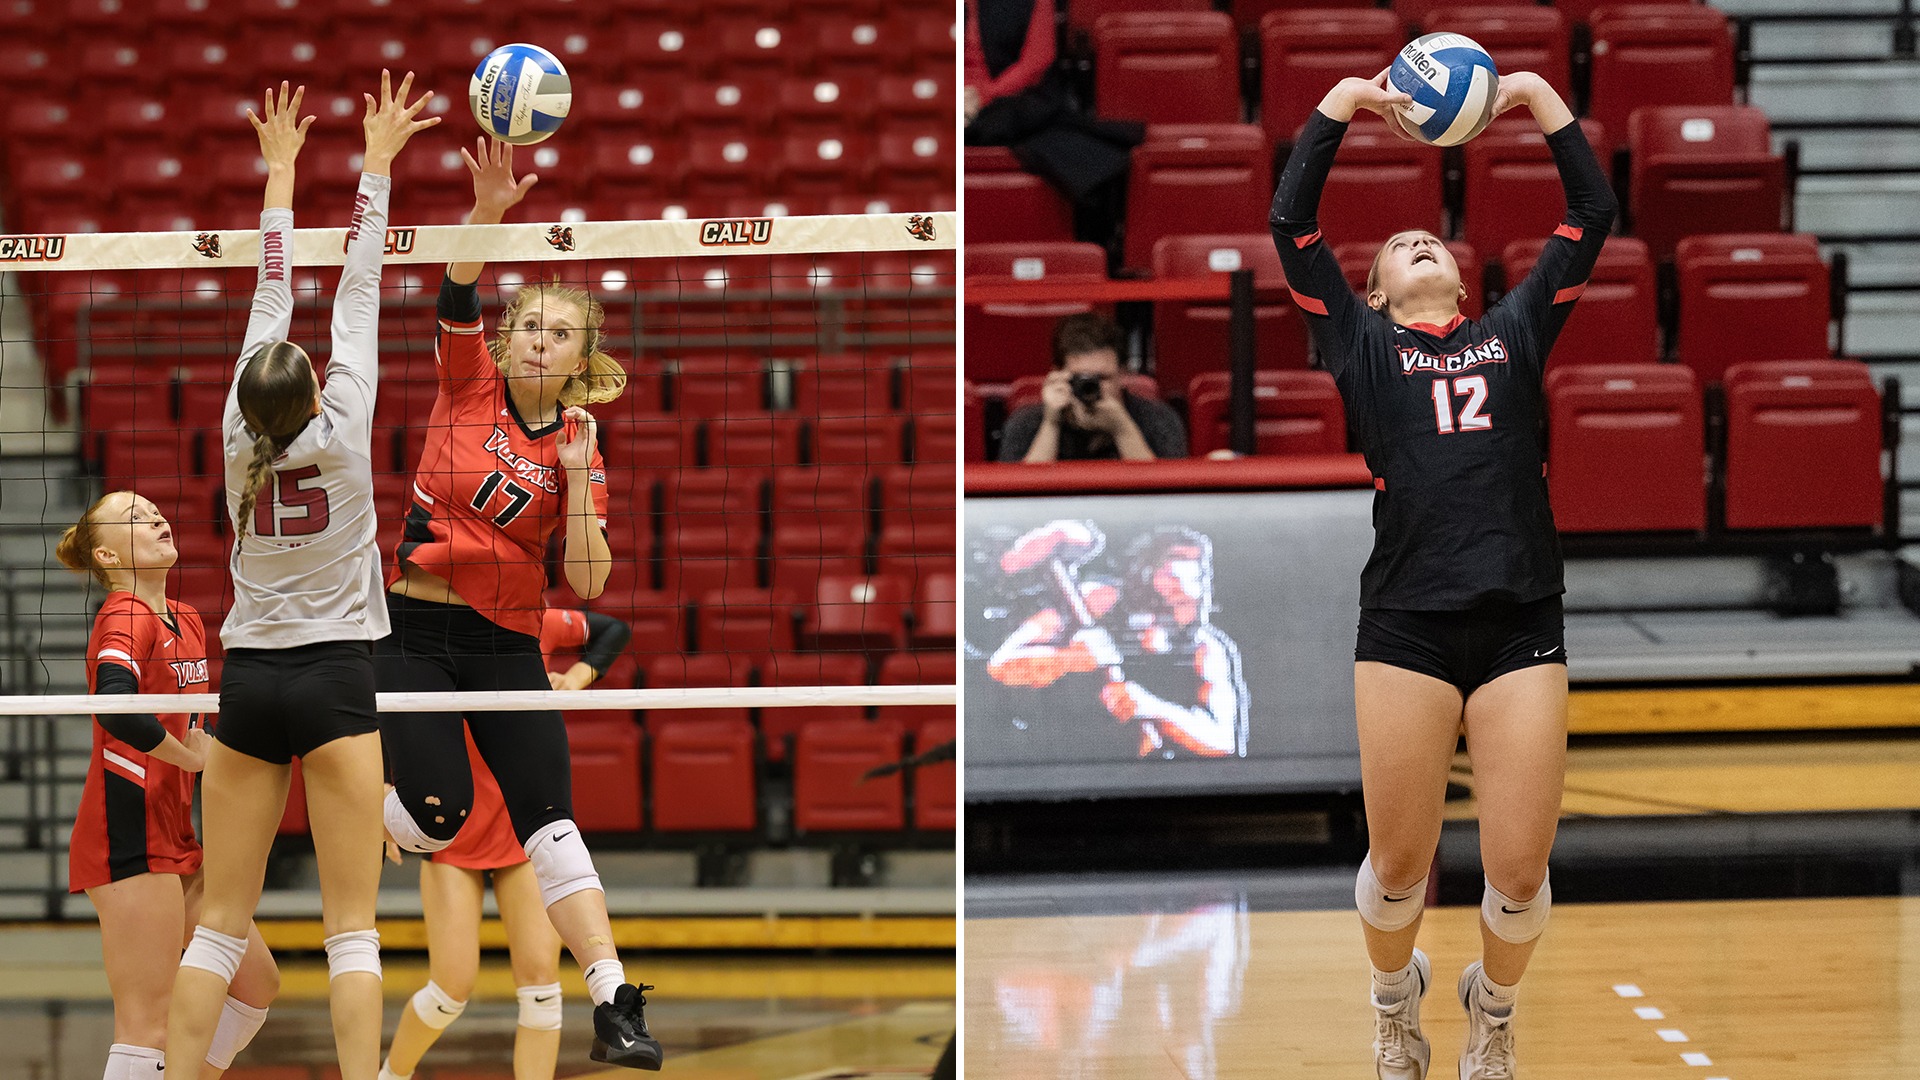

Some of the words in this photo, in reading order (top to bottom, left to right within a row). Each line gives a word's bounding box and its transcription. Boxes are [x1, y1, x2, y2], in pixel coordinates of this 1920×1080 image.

[1403, 44, 1437, 80] molten
[480, 64, 500, 119] molten
[493, 72, 517, 120] NCAA
[514, 101, 528, 126] Super
[522, 73, 533, 102] Touch
[350, 192, 370, 241] HAVEN
[264, 231, 284, 281] NATION
[1396, 336, 1508, 375] VULCANS
[1432, 375, 1492, 434] 12
[483, 424, 559, 494] VULCANS
[253, 463, 330, 537] 15
[470, 469, 534, 528] 17
